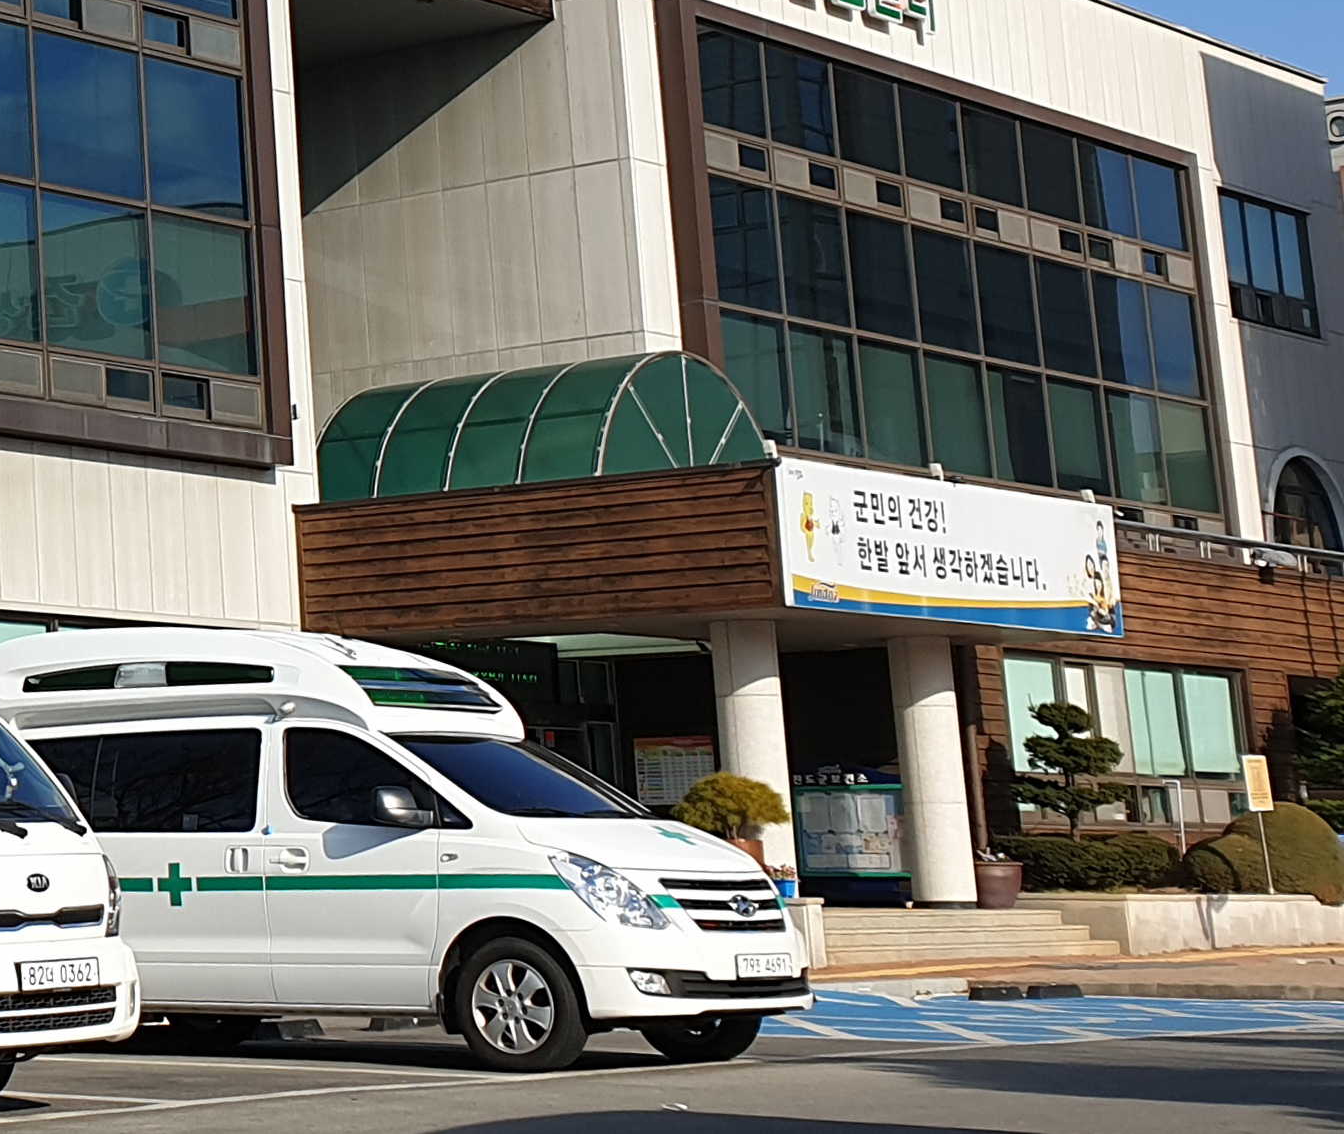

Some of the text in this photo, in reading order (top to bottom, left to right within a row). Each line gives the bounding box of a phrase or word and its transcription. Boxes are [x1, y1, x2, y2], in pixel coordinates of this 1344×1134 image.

[852, 490, 947, 534] 군민의 건강!
[856, 536, 1047, 591] 한발 앞서 생각하겠습니다.
[793, 773, 868, 785] 진도군보건소
[29, 962, 92, 985] 82더 0362
